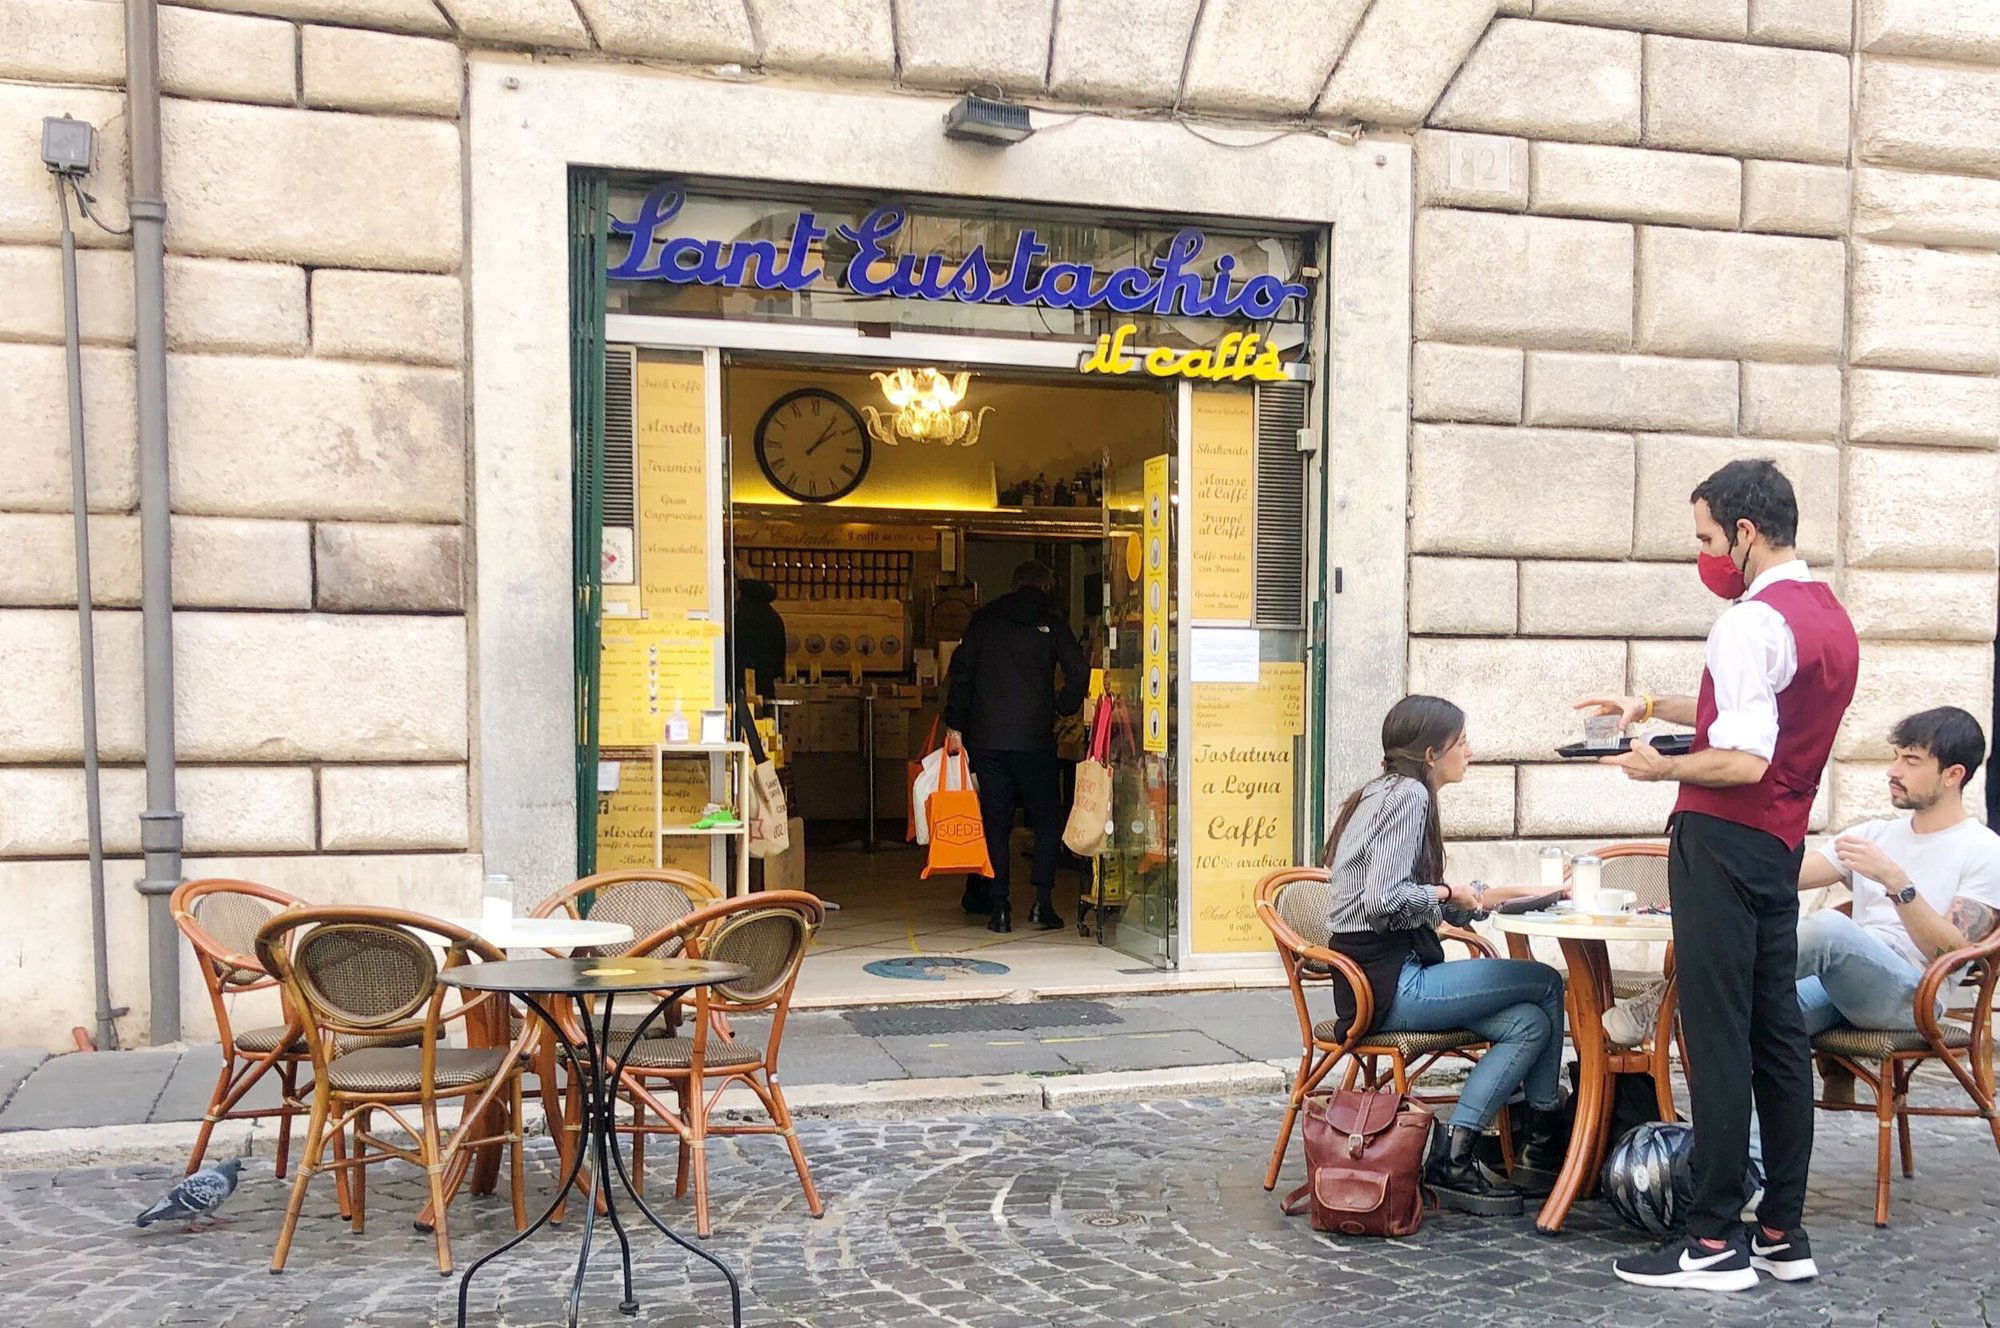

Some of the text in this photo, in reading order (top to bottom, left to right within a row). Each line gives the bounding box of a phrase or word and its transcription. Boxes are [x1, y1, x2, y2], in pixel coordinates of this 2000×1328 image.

[1461, 147, 1497, 180] 82
[606, 179, 1309, 321] Sant Eustachio
[1083, 323, 1138, 374] il
[640, 418, 703, 436] Moretto
[1197, 442, 1249, 456] Shakerato
[1200, 472, 1247, 487] Mousse
[660, 494, 687, 506] Gran
[1198, 486, 1211, 499] al
[643, 508, 704, 523] Cappuccino
[1198, 523, 1212, 536] al
[645, 583, 672, 595] Gran
[1194, 744, 1290, 764] Tostatura
[1202, 774, 1282, 800] a Legna
[1194, 853, 1288, 870] 100% arabica
